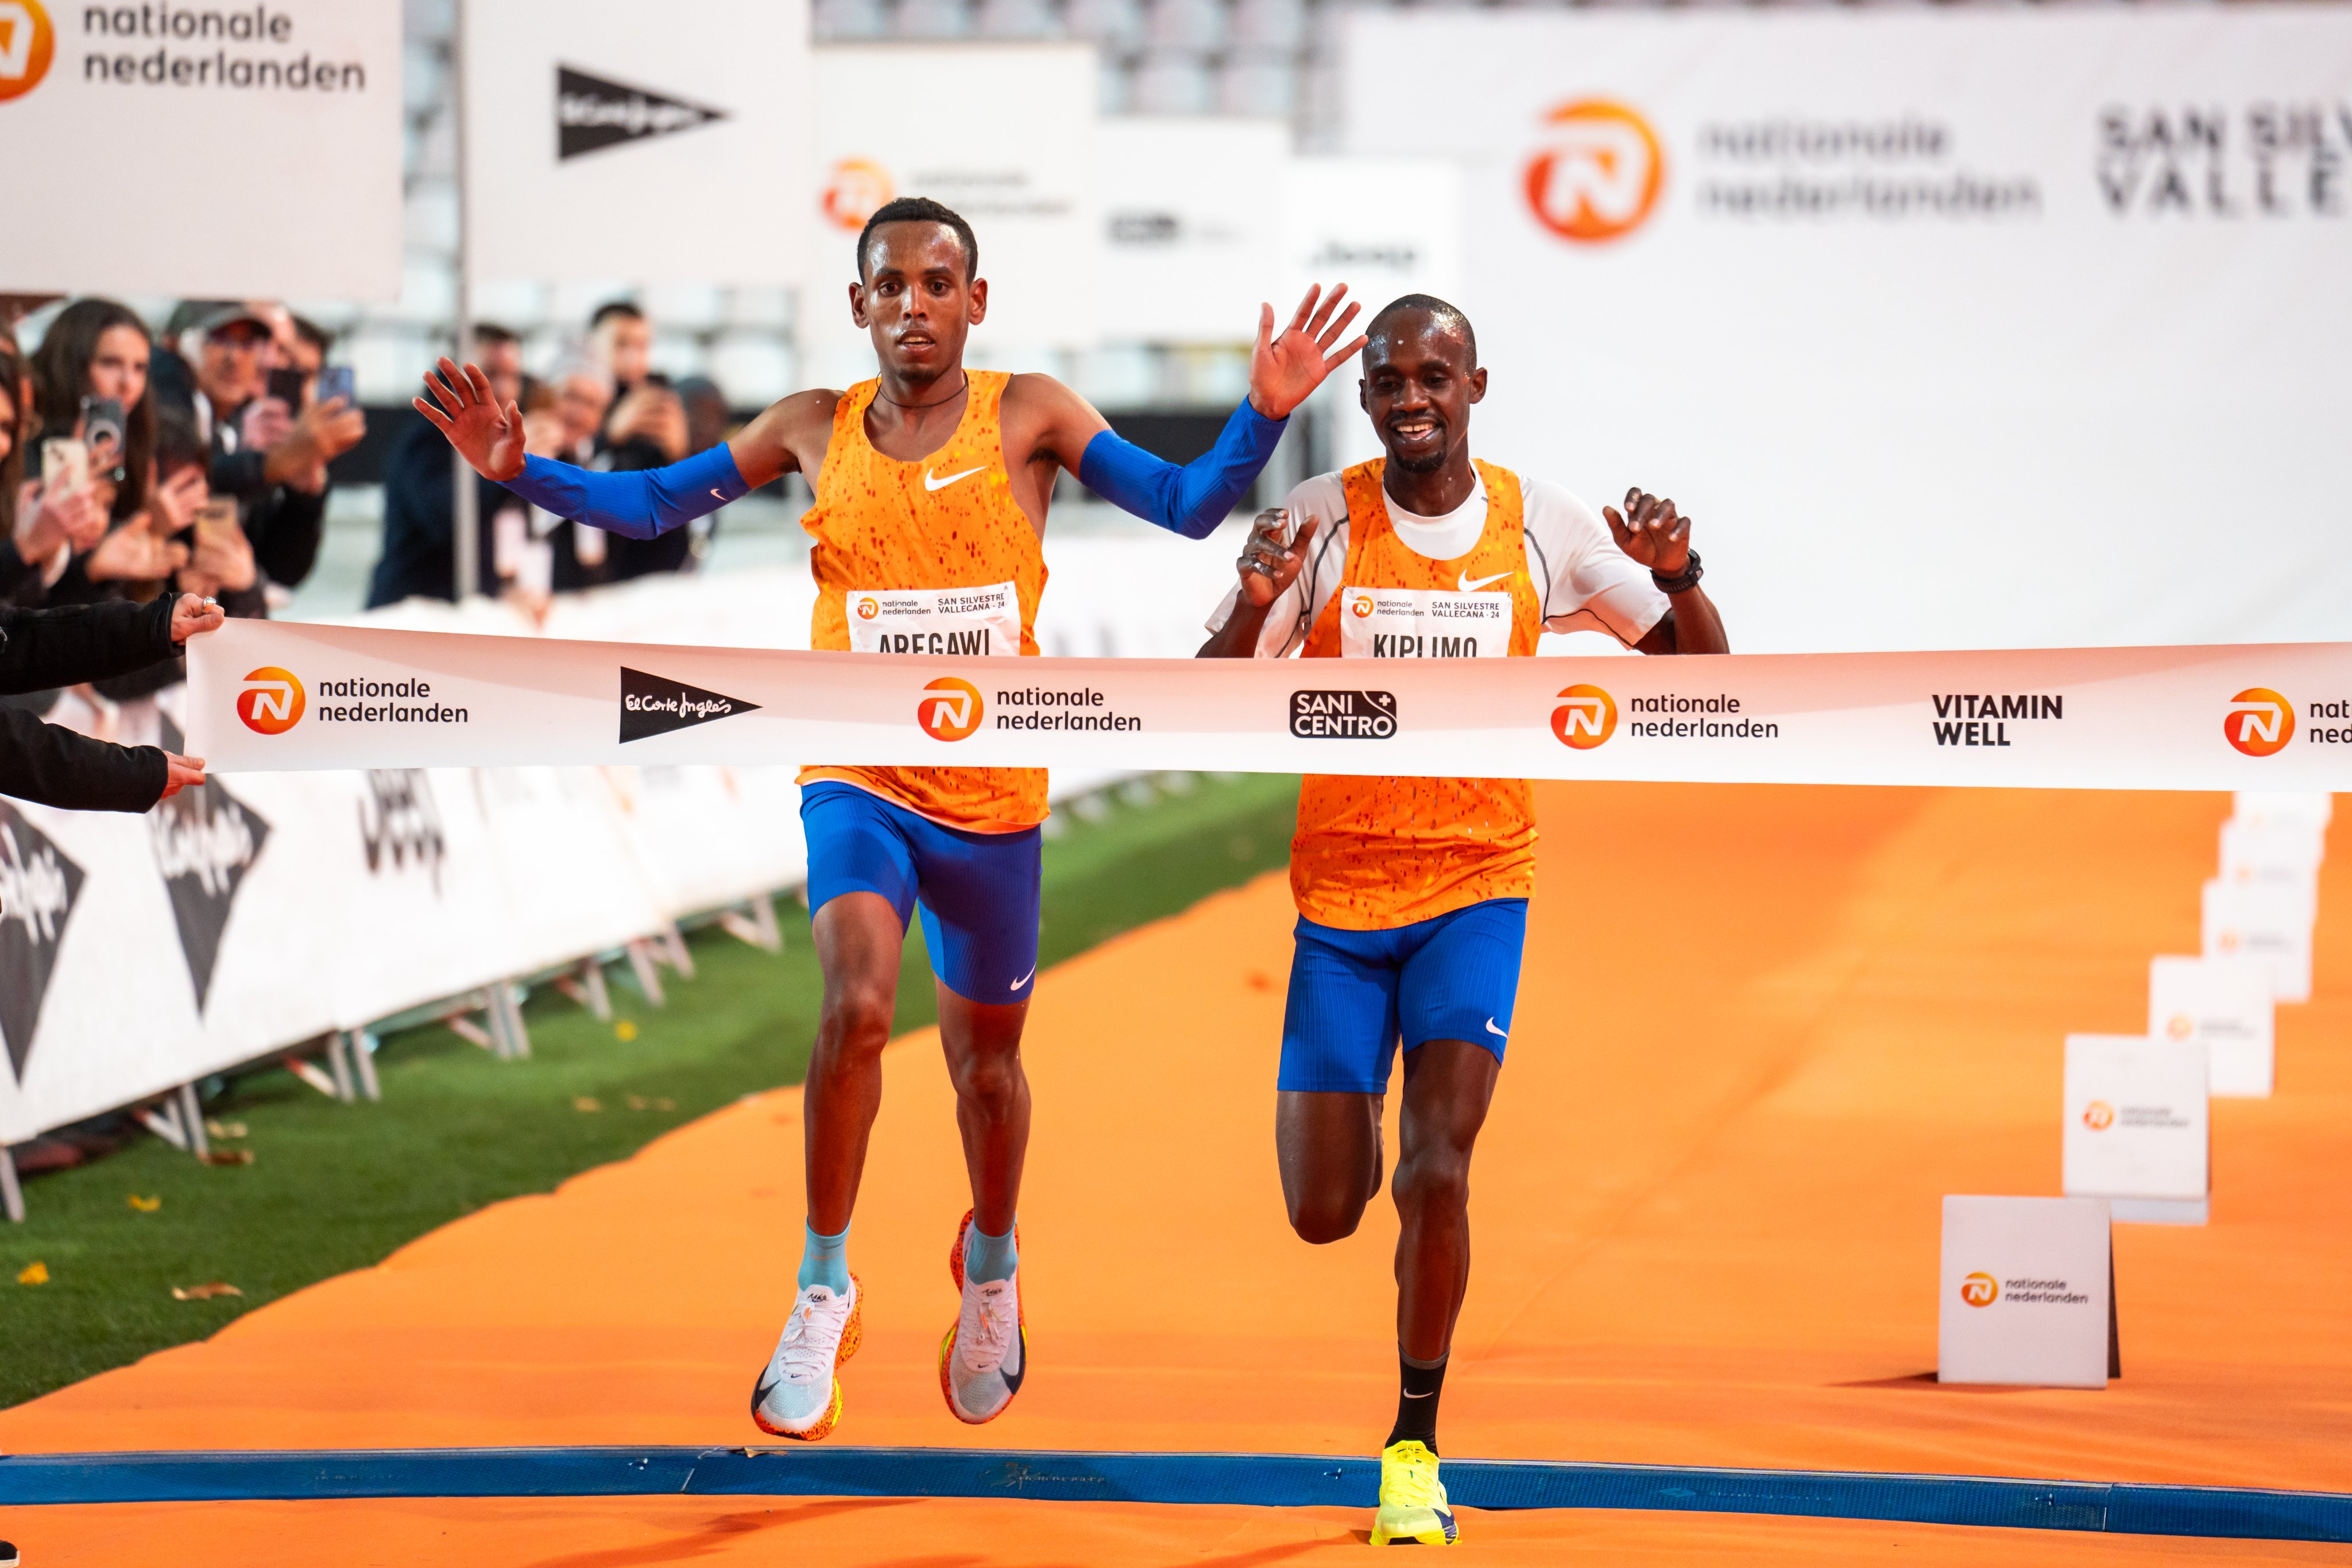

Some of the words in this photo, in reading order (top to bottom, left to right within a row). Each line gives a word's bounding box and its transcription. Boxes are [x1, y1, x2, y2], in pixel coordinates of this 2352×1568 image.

[84, 3, 292, 42] nationale
[84, 48, 366, 89] nederlanden
[938, 603, 990, 614] VALLECANA
[960, 593, 1005, 605] SILVESTRE
[1377, 609, 1424, 617] nederlanden
[1432, 610, 1484, 618] VALLECANA
[320, 677, 430, 698] nationale
[997, 687, 1104, 707] nationale
[319, 702, 468, 723] nederlanden
[641, 695, 678, 712] Corte
[1297, 694, 1352, 714] SANI
[1631, 694, 1740, 713] nationale
[1932, 695, 2063, 719] VITAMIN
[2310, 700, 2352, 718] nat
[997, 710, 1141, 731] nederlanden
[1295, 716, 1392, 735] CENTRO
[1631, 717, 1778, 738] nederlanden
[1933, 722, 2010, 746] WELL
[2005, 1279, 2067, 1290] nationale
[2005, 1292, 2088, 1304] nederlanden
